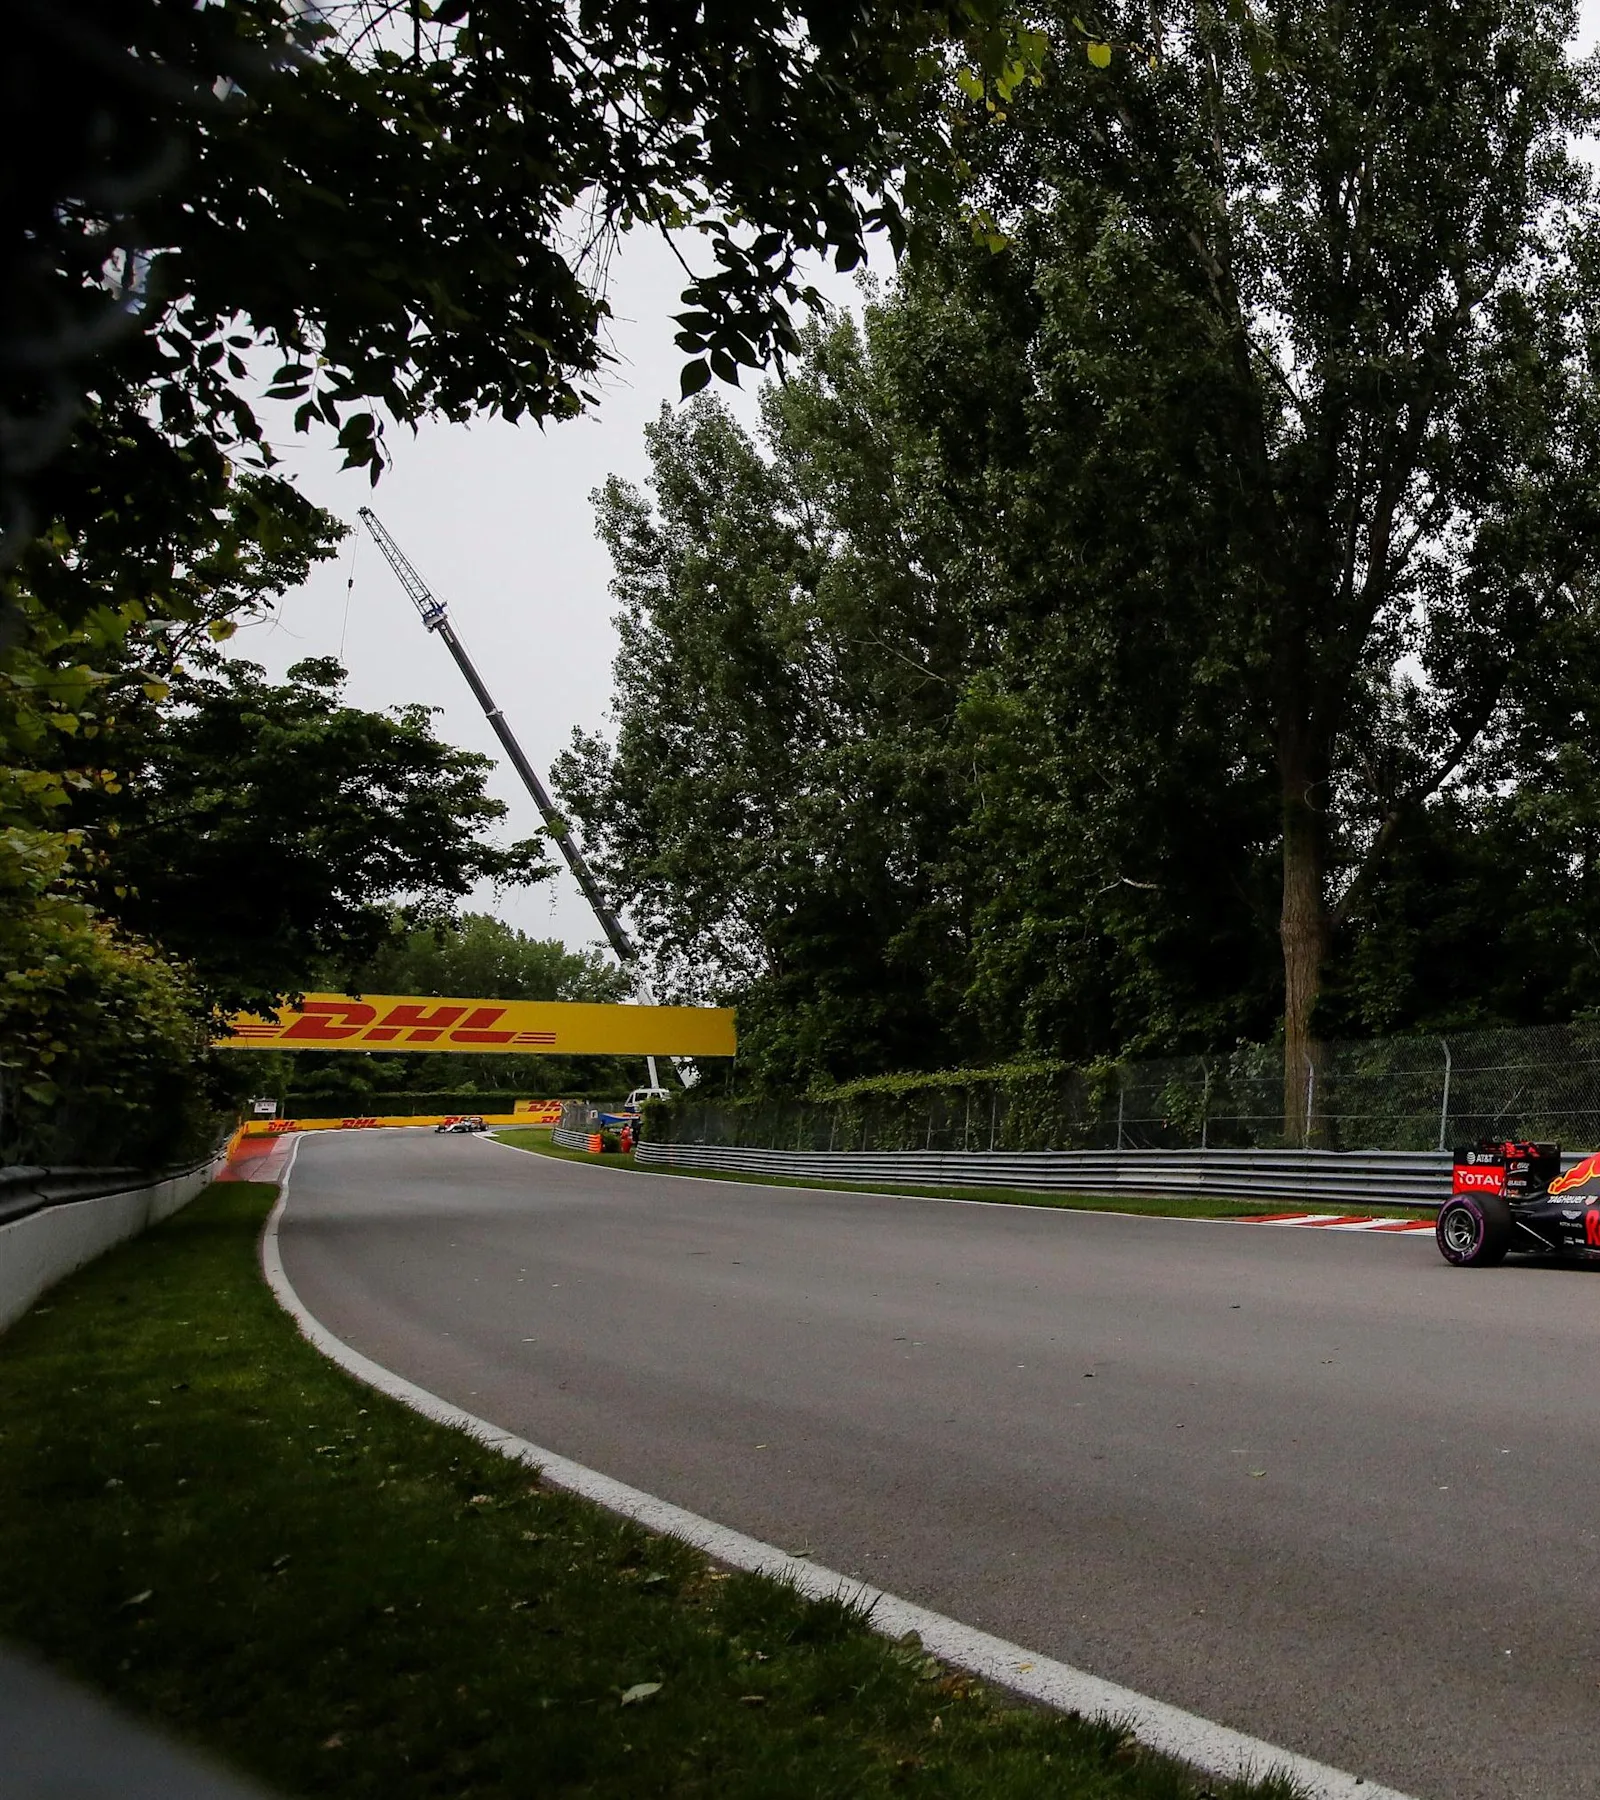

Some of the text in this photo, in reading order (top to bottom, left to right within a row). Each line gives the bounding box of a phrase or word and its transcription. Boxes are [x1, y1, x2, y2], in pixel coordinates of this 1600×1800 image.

[279, 1002, 518, 1043] DHL
[268, 1121, 298, 1131] DHL
[341, 1119, 377, 1128] DHL
[1476, 1154, 1494, 1163] AT&T
[1457, 1170, 1502, 1186] TOTAL
